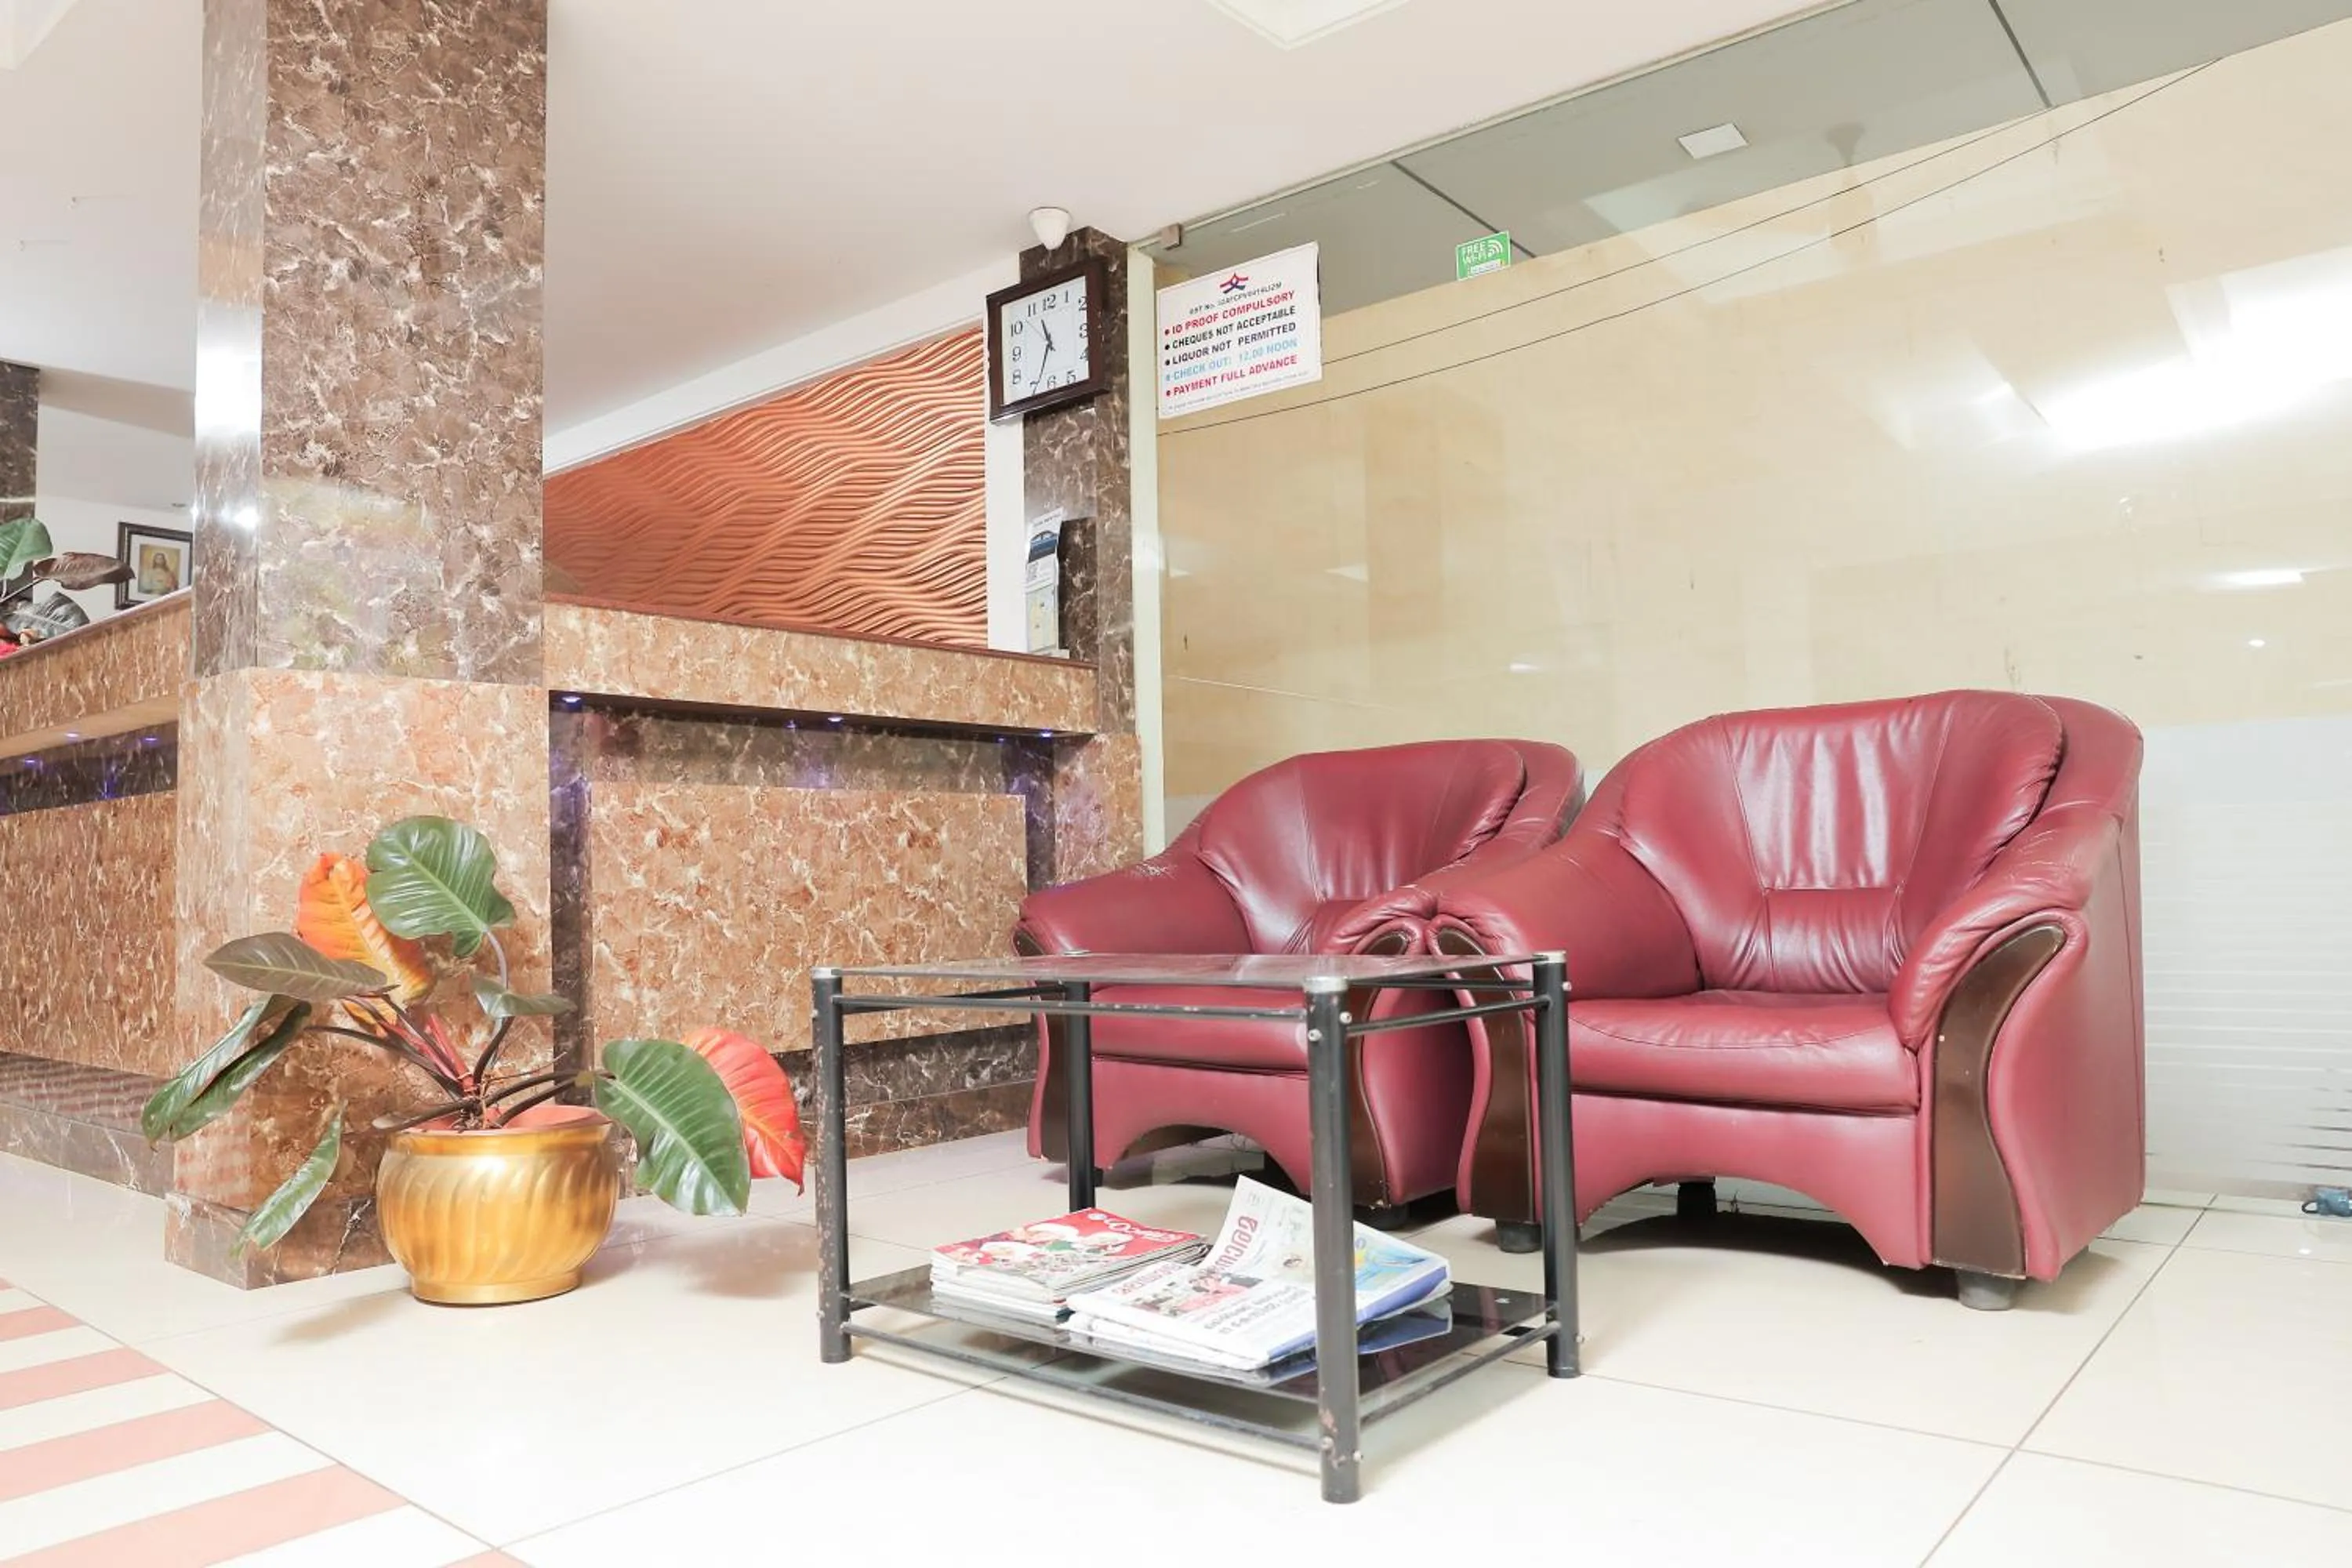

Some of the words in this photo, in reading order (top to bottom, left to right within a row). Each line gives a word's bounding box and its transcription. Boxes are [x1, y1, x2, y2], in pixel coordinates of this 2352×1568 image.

[1042, 294, 1056, 311] 12
[1063, 289, 1069, 303] 1
[1078, 296, 1087, 311] 2
[1028, 303, 1036, 318] 11
[1185, 313, 1218, 330] PROOF
[1222, 290, 1294, 319] COMPULSORY
[1011, 321, 1023, 337] 10
[1080, 323, 1088, 339] 3
[1172, 329, 1214, 349] CHEQUES
[1216, 323, 1234, 336] NOT
[1236, 305, 1296, 330] ACCEPTABLE
[1172, 347, 1210, 365] LIQUOR
[1211, 339, 1232, 353] NOT
[1238, 321, 1296, 346] PERMITTED
[1012, 346, 1021, 361] 9
[1174, 363, 1206, 380] CHECK
[1266, 337, 1298, 354] NOON
[1012, 370, 1021, 385] 8
[1047, 375, 1056, 390] 6
[1066, 370, 1076, 384] 5
[1173, 376, 1218, 395] PAYMENT
[1221, 368, 1246, 383] FULL
[1249, 354, 1298, 375] ADVANCE
[1029, 380, 1040, 396] 7
